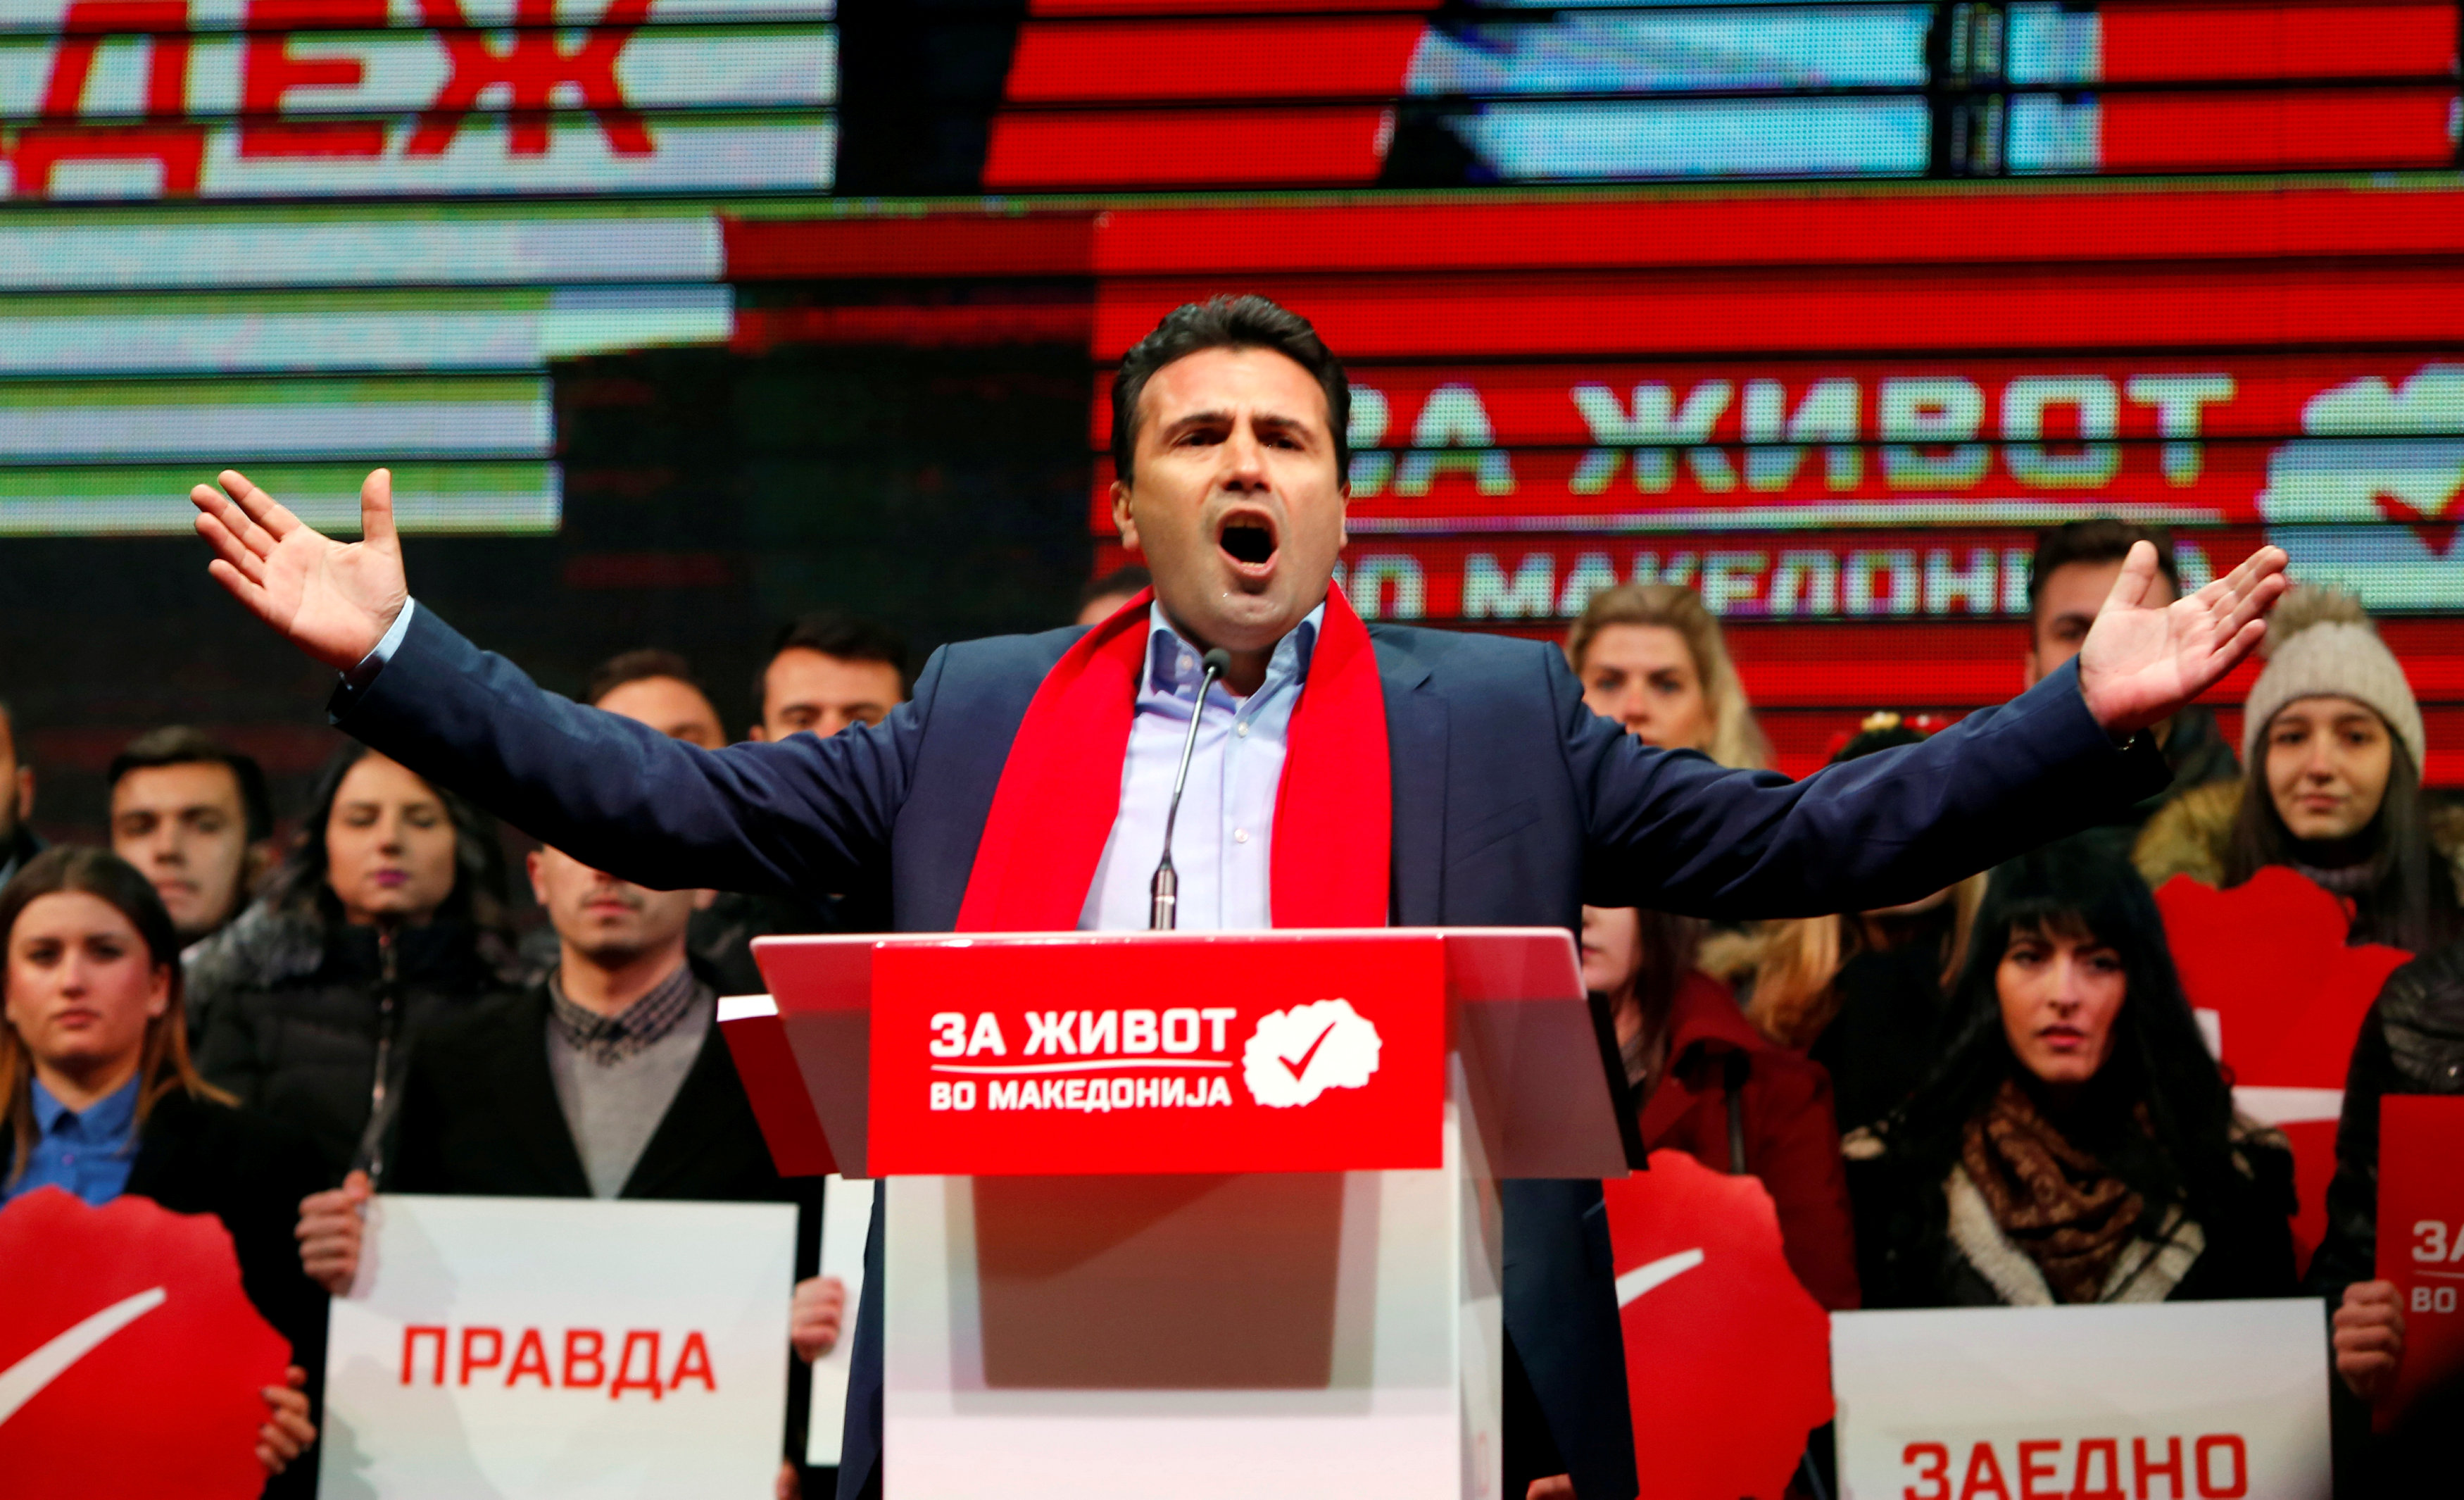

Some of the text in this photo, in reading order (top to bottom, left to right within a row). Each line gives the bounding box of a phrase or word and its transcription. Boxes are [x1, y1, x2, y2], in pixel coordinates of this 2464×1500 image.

[0, 0, 658, 198] ДЕЖ
[1568, 373, 2235, 492] ЖИВОТ
[930, 1008, 1237, 1057] ЗА ЖИВОТ
[930, 1077, 1233, 1113] ВО МАКЕДОНИЈА
[2412, 1220, 2464, 1262] З
[2411, 1286, 2457, 1313] ВО
[400, 1325, 717, 1401] ПРАВДА
[1902, 1433, 2248, 1500] ЗАЕДНО
